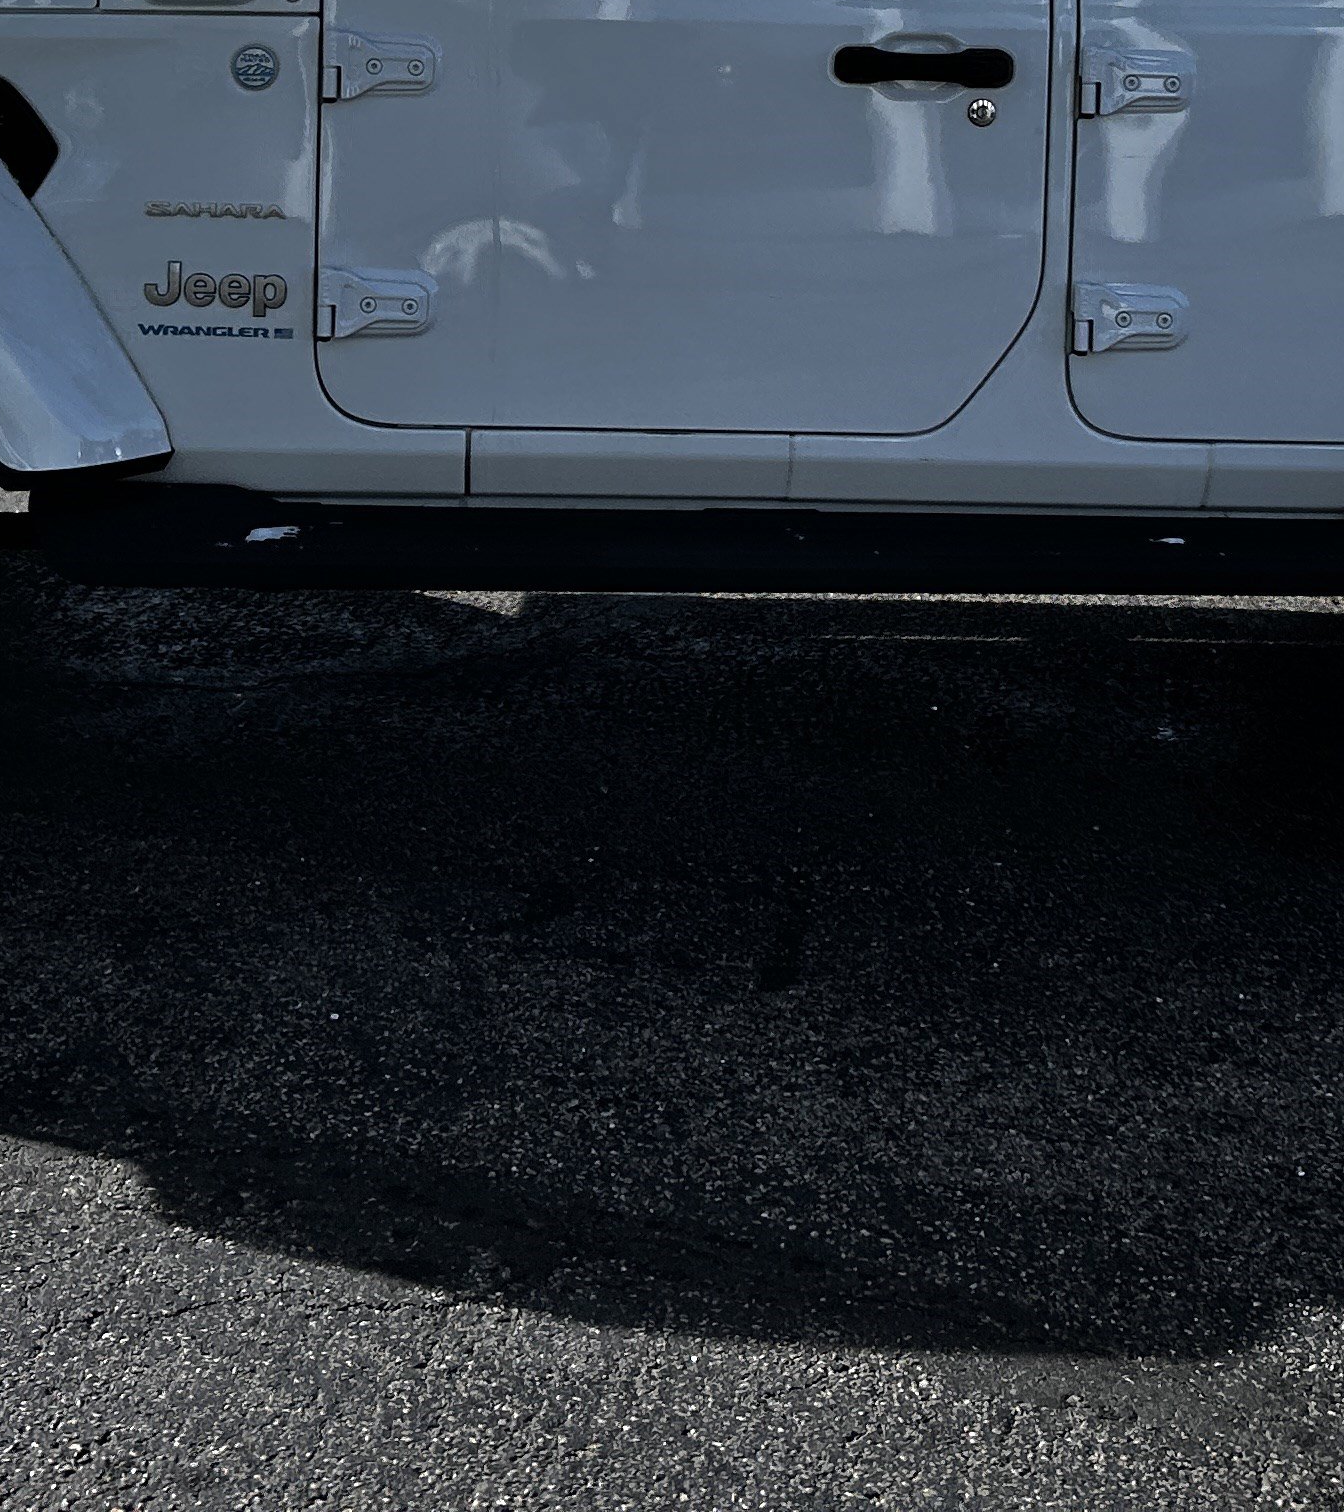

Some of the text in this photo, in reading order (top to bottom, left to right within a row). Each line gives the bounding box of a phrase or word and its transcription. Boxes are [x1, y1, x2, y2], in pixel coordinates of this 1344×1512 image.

[144, 200, 287, 220] SAHARA
[144, 260, 288, 317] Jeep
[137, 323, 271, 338] WRANGLER
